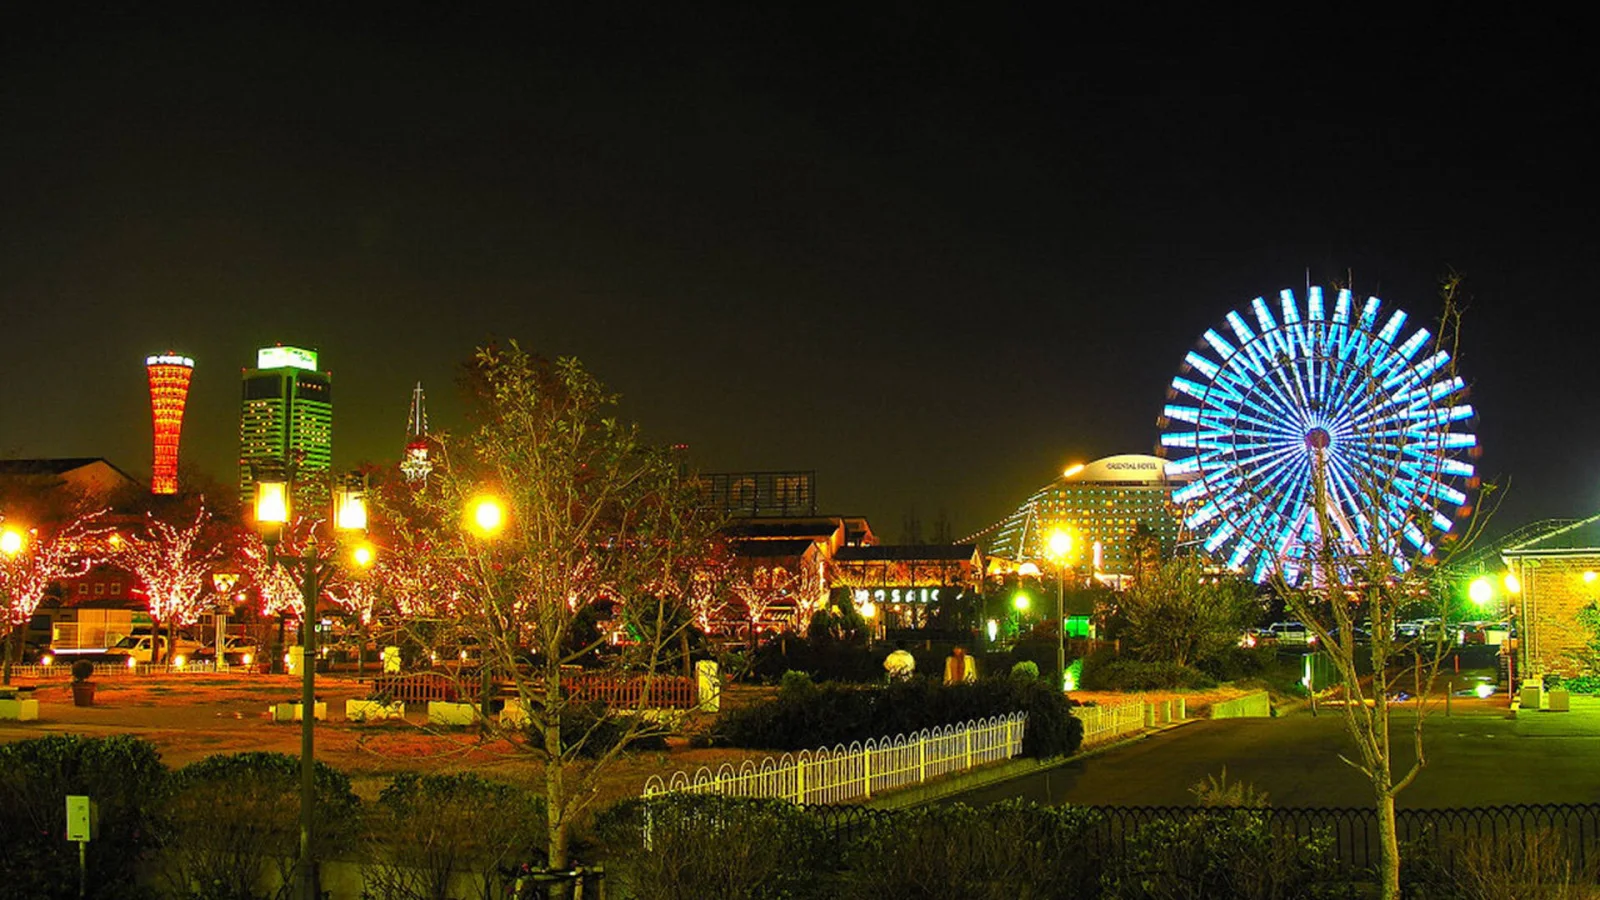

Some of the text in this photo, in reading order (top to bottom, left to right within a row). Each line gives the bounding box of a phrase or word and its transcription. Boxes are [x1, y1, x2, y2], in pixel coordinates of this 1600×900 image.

[1106, 462, 1157, 470] ORIENTAL HOTEL
[854, 588, 940, 603] MOSAIC
